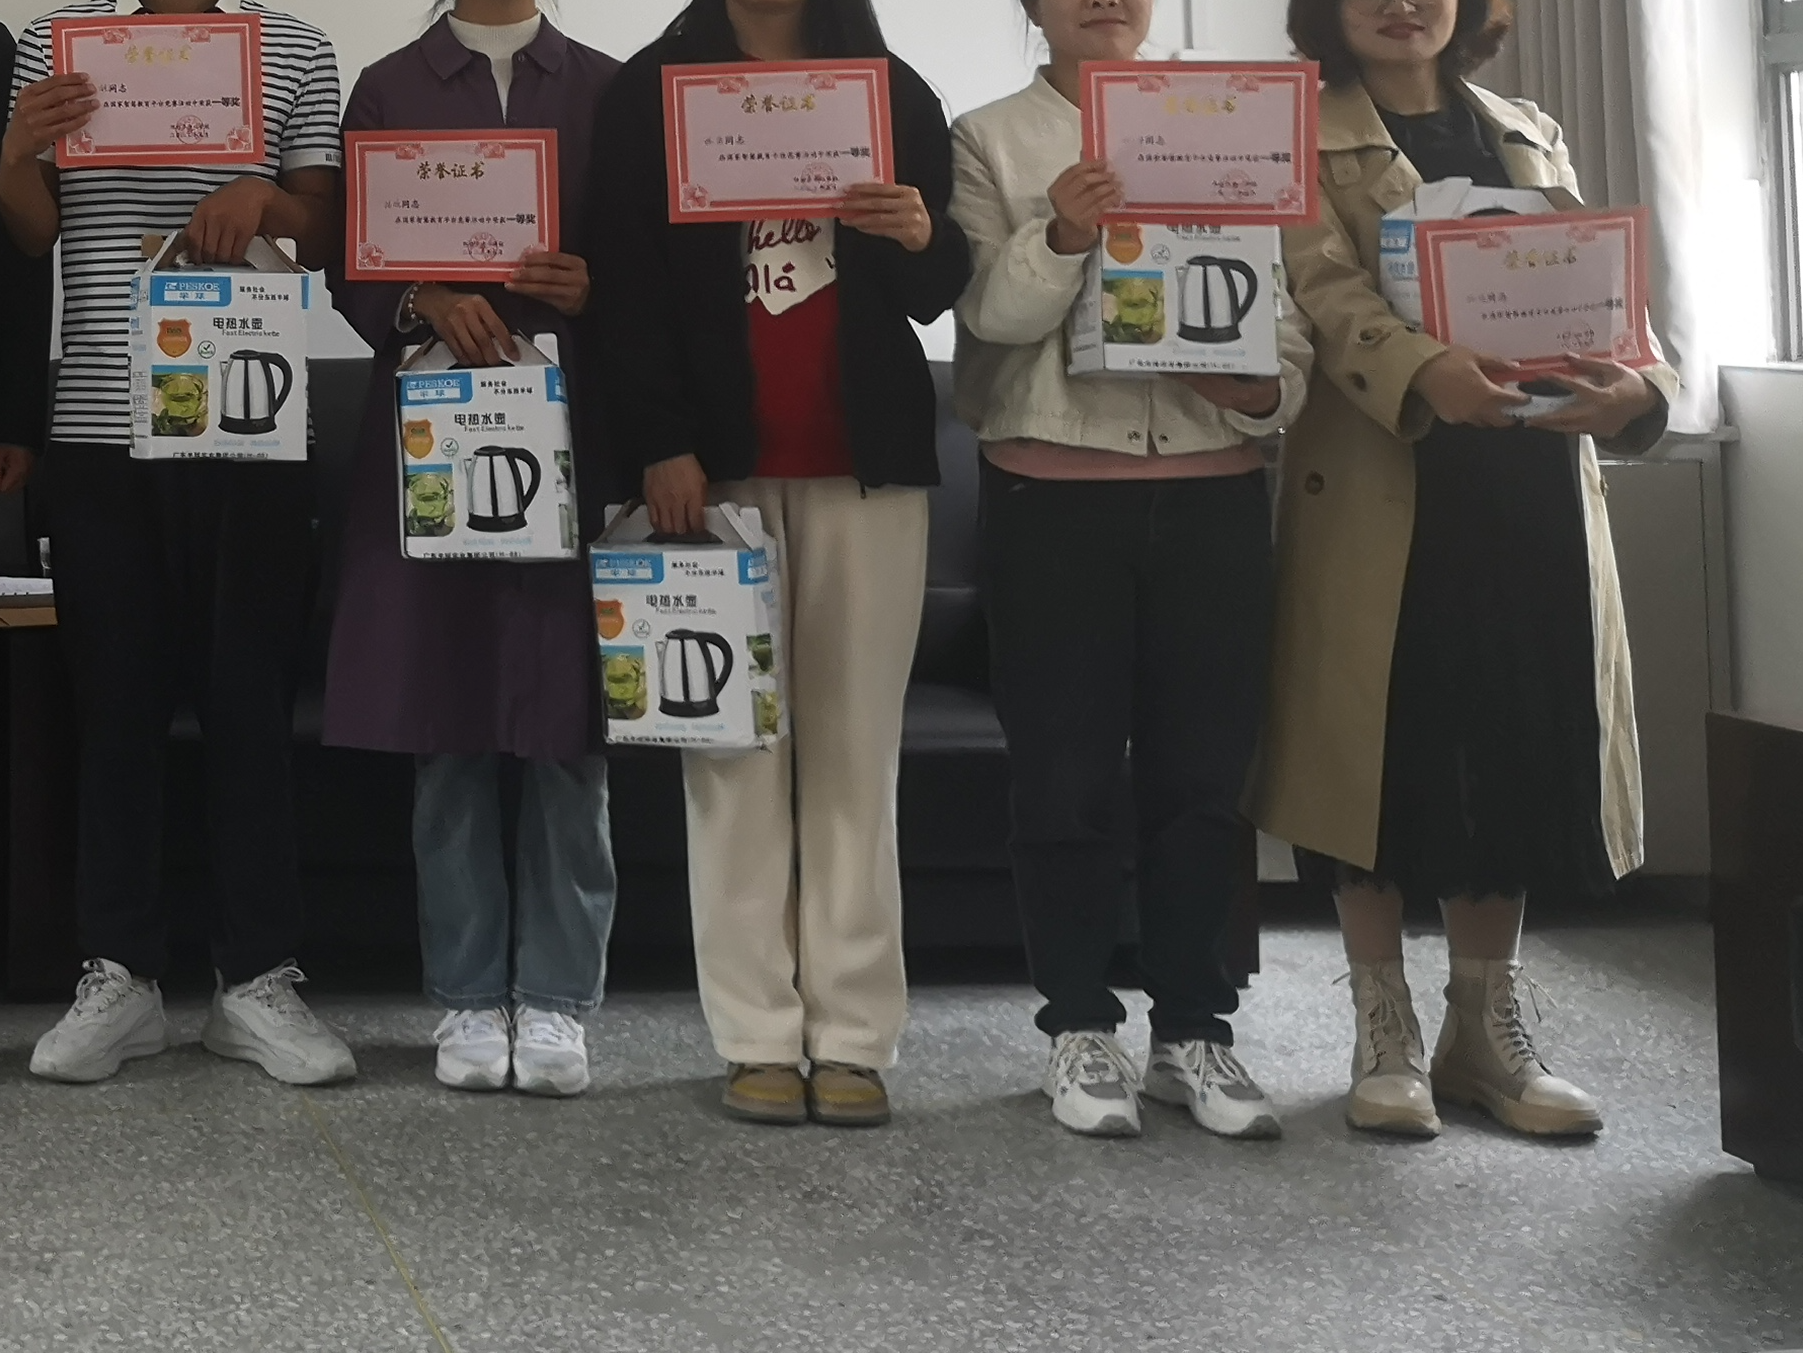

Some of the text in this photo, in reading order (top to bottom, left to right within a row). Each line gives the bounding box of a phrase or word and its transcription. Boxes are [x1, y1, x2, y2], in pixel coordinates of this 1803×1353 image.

[416, 160, 486, 180] 荣誉证书
[213, 317, 263, 330] 电热水壶
[454, 412, 506, 426] 电热水壶
